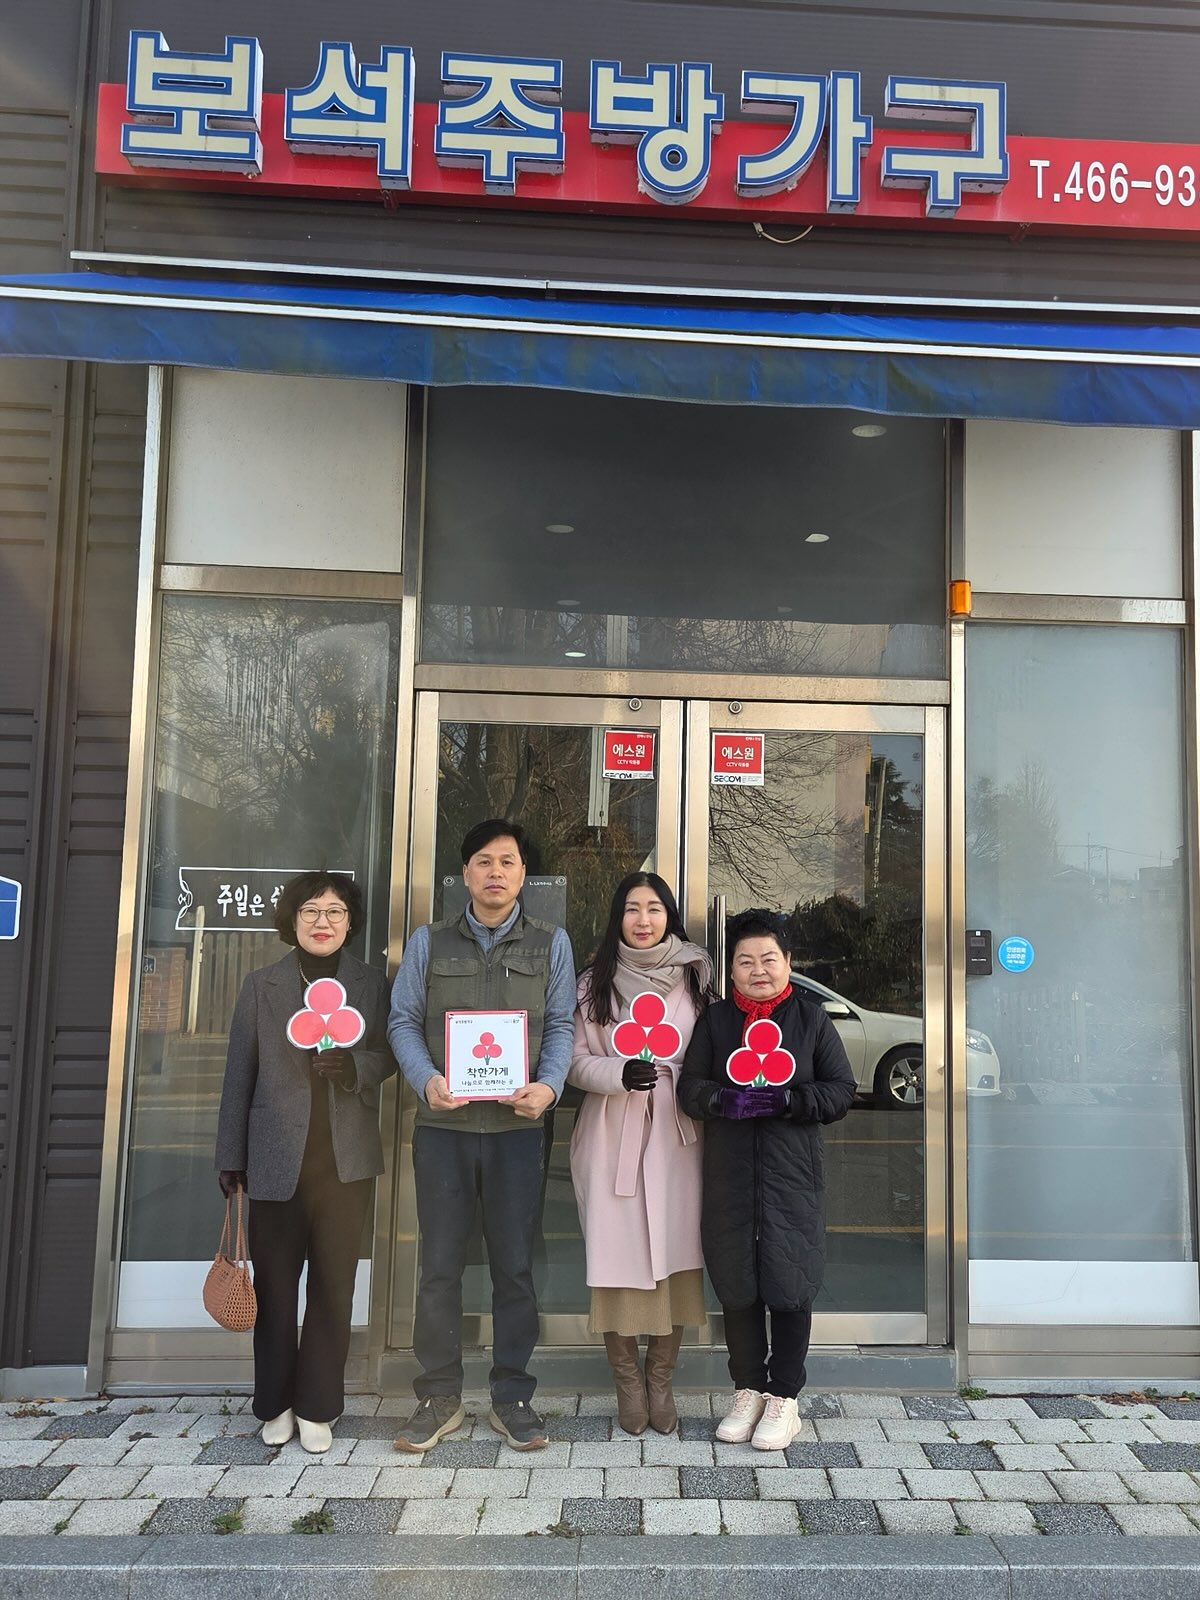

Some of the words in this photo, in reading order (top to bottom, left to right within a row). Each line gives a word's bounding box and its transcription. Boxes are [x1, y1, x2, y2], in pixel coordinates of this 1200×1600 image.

[120, 30, 1009, 216] 보석주방가구
[1028, 159, 1200, 208] T.466-93
[612, 743, 646, 758] 에스원
[721, 746, 754, 761] 에스원
[714, 775, 742, 783] SECOM
[216, 884, 266, 918] 주일은
[467, 1067, 509, 1078] 착한가게
